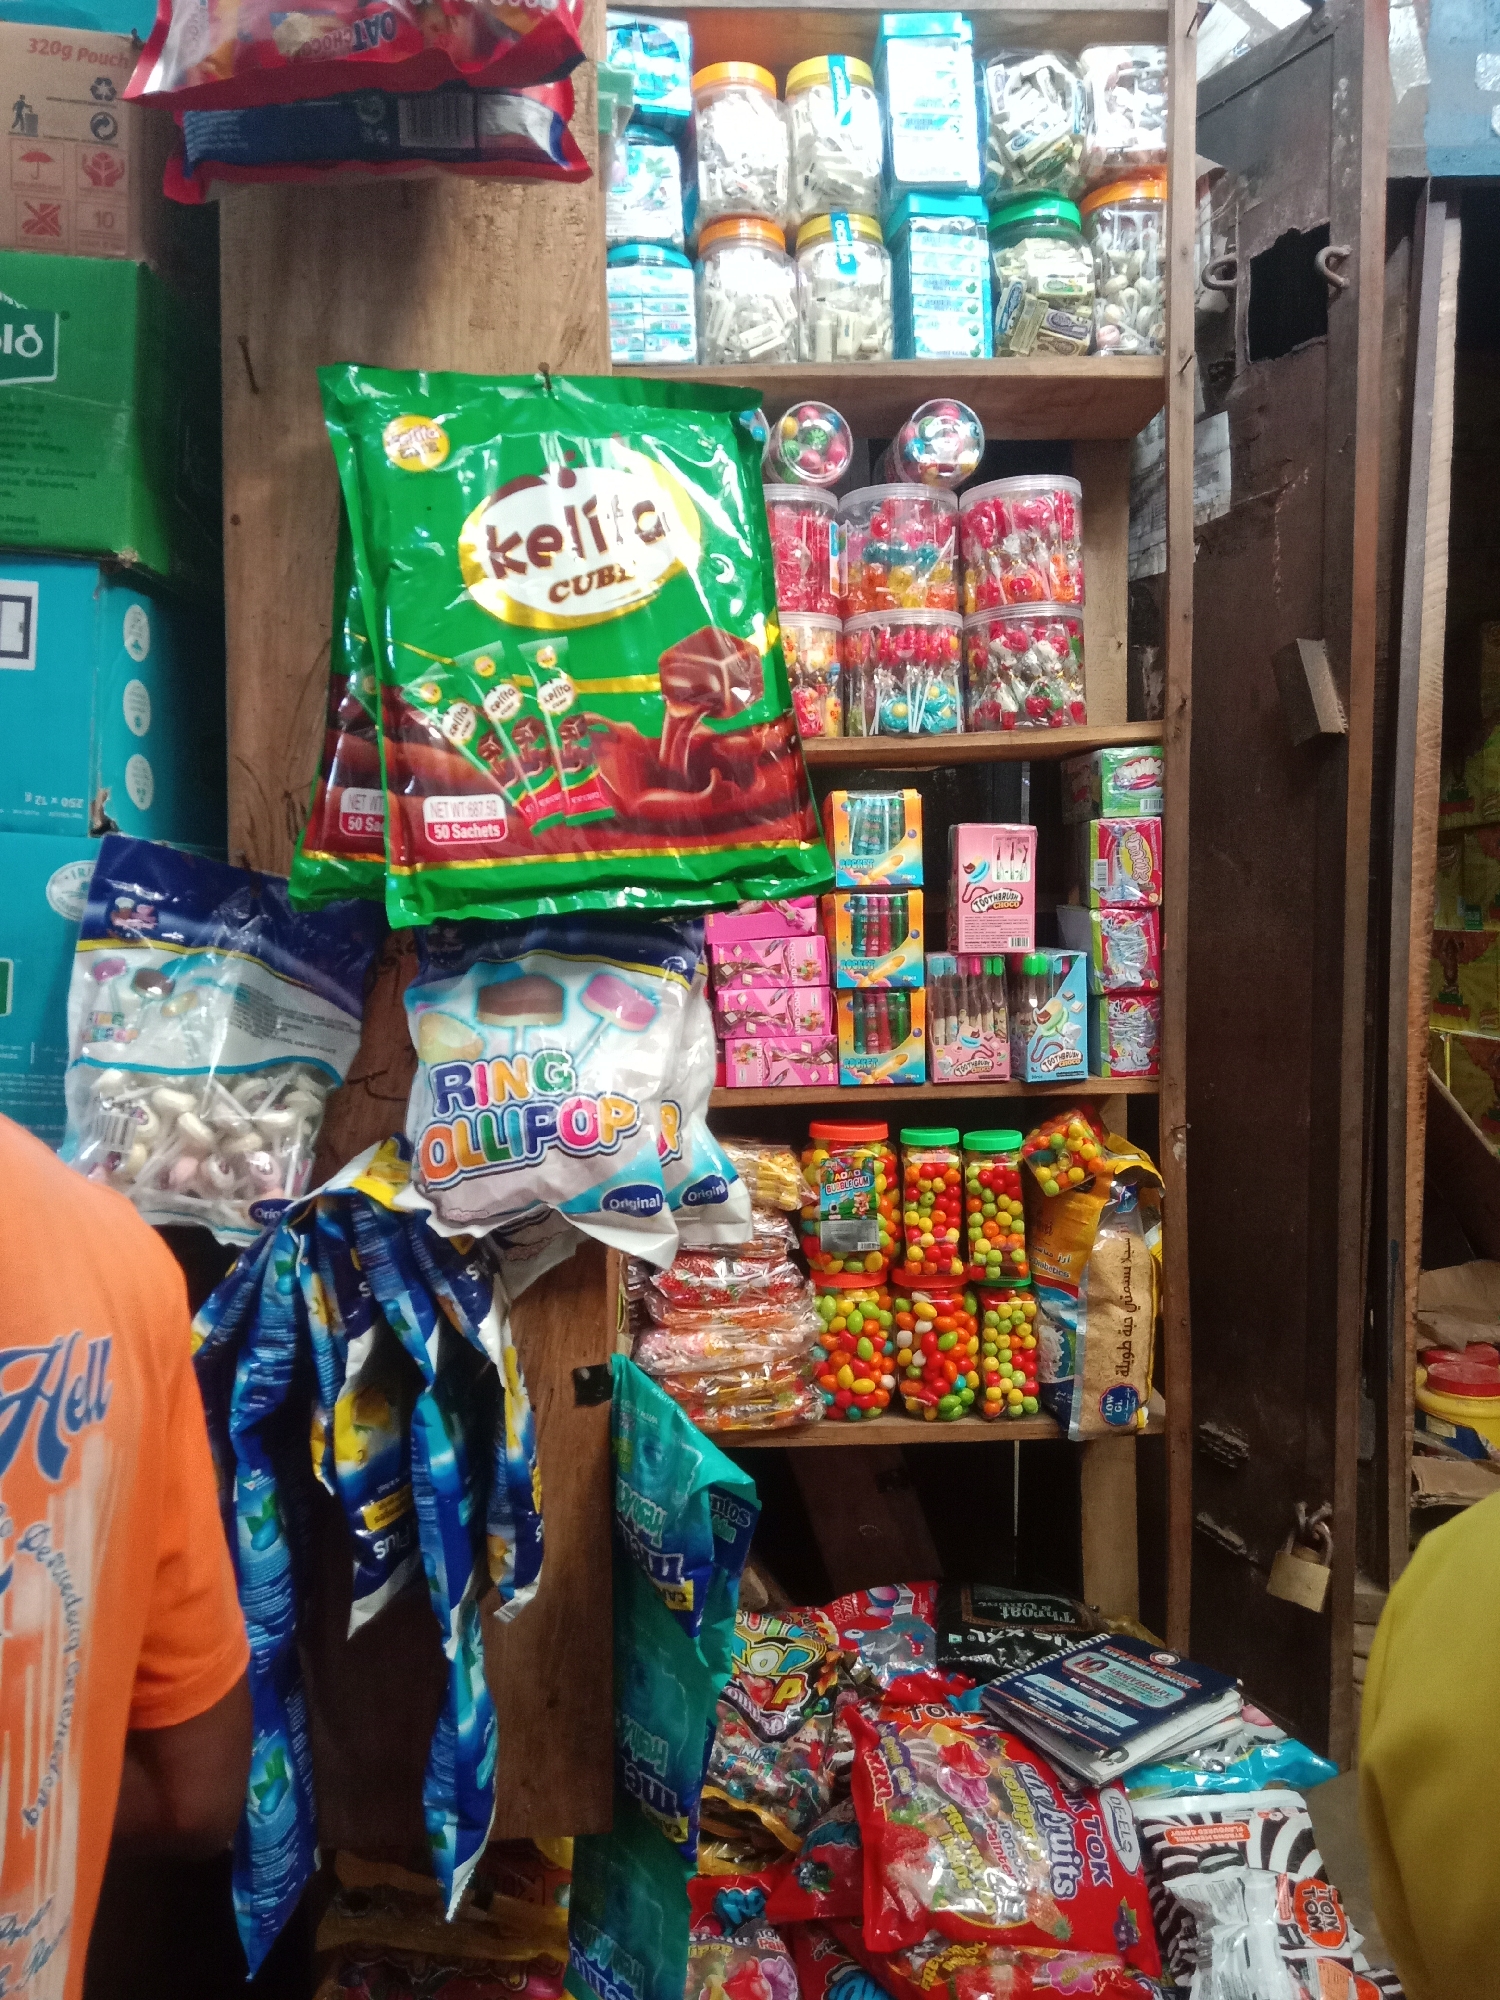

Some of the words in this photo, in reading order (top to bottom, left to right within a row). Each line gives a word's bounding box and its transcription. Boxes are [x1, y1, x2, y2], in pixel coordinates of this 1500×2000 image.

[28, 37, 74, 61] 320g
[76, 47, 130, 69] Pouch
[350, 794, 367, 811] NET
[430, 801, 449, 818] NET
[347, 817, 363, 831] 50
[433, 824, 450, 839] 50
[452, 822, 501, 838] Sachets
[973, 892, 1019, 911] TOOTHBRUSH
[992, 901, 1020, 910] CHOCO
[840, 959, 876, 970] ROCKET
[843, 1057, 878, 1069] ROCKET
[955, 1058, 990, 1075] TOOTHBRUSH
[1042, 1051, 1080, 1071] TOOTHBRUSH
[431, 1049, 577, 1117] RING
[418, 1095, 640, 1192] OLLIPOP
[825, 1179, 854, 1195] BUBBLE
[853, 1175, 870, 1189] GUM
[609, 1192, 662, 1211] Original
[1115, 1340, 1135, 1377] طويلة
[1105, 1394, 1114, 1416] LOW
[999, 1607, 1076, 1624] Throat
[1107, 1667, 1174, 1699] ANNIVERSARY
[863, 1750, 894, 1807] XXXL
[939, 1804, 973, 1843] FREE
[1043, 1806, 1085, 1901] Fruits
[1083, 1814, 1114, 1889] TOK
[1302, 1885, 1325, 1933] TOM
[1317, 1886, 1342, 1933] TOM
